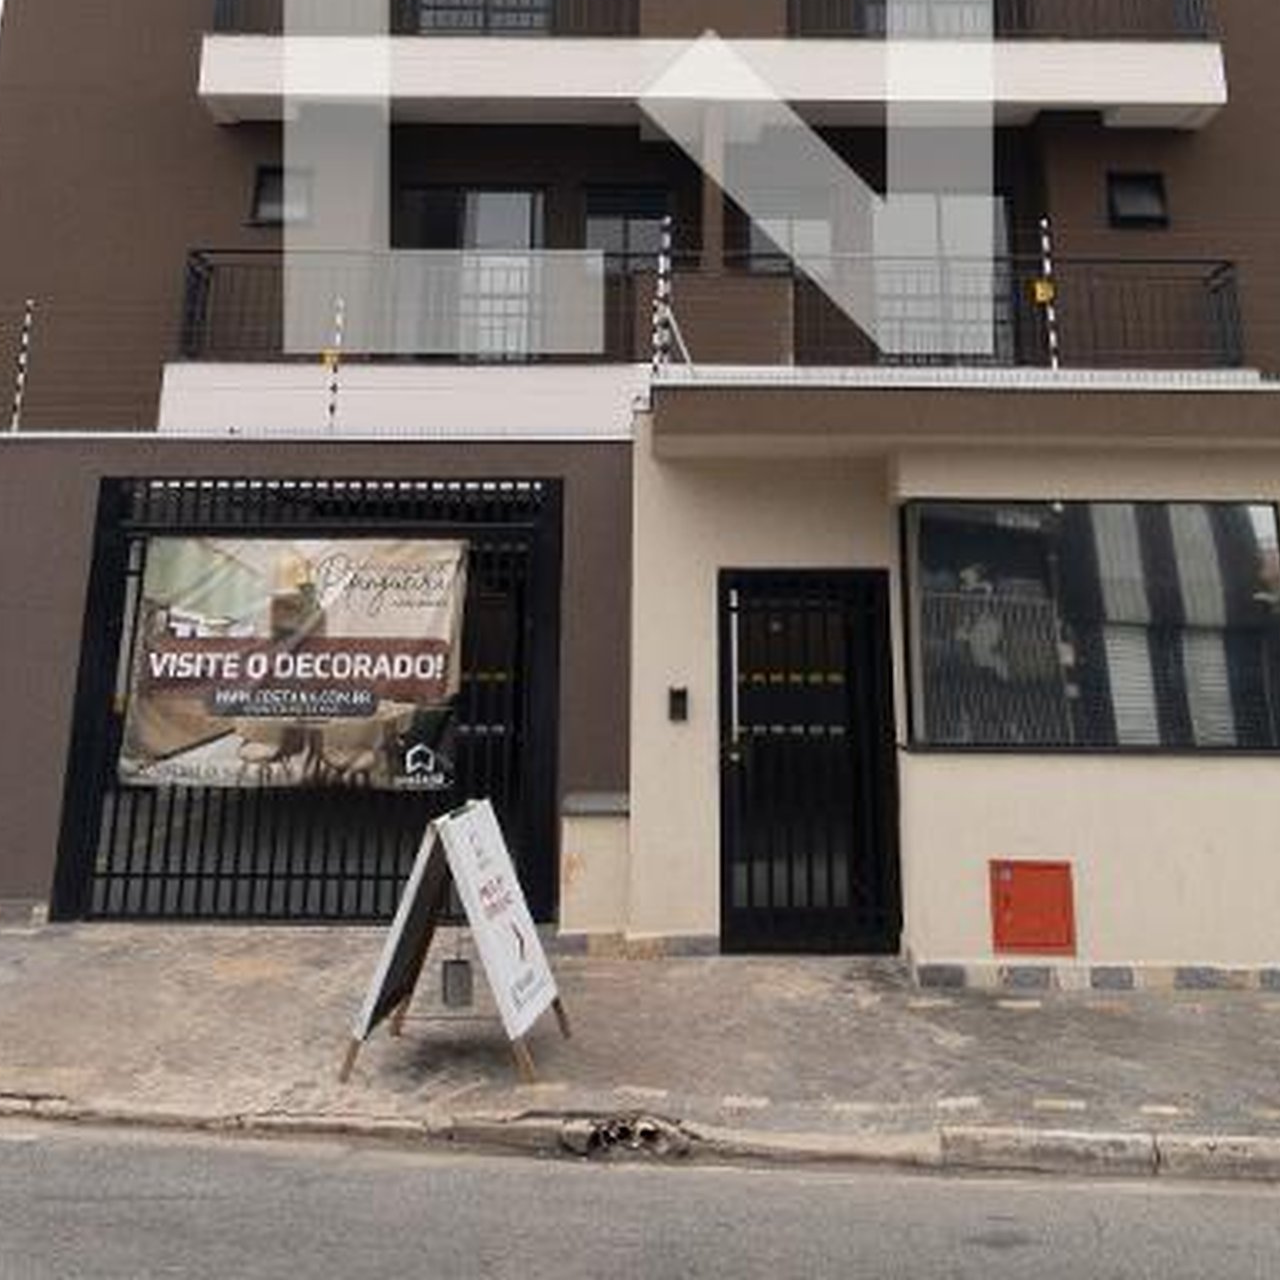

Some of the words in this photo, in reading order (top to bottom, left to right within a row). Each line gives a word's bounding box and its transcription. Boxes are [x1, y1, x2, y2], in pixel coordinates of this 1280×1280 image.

[149, 651, 240, 679] VISITE
[247, 652, 267, 678] O
[274, 652, 444, 681] DECORADO!
